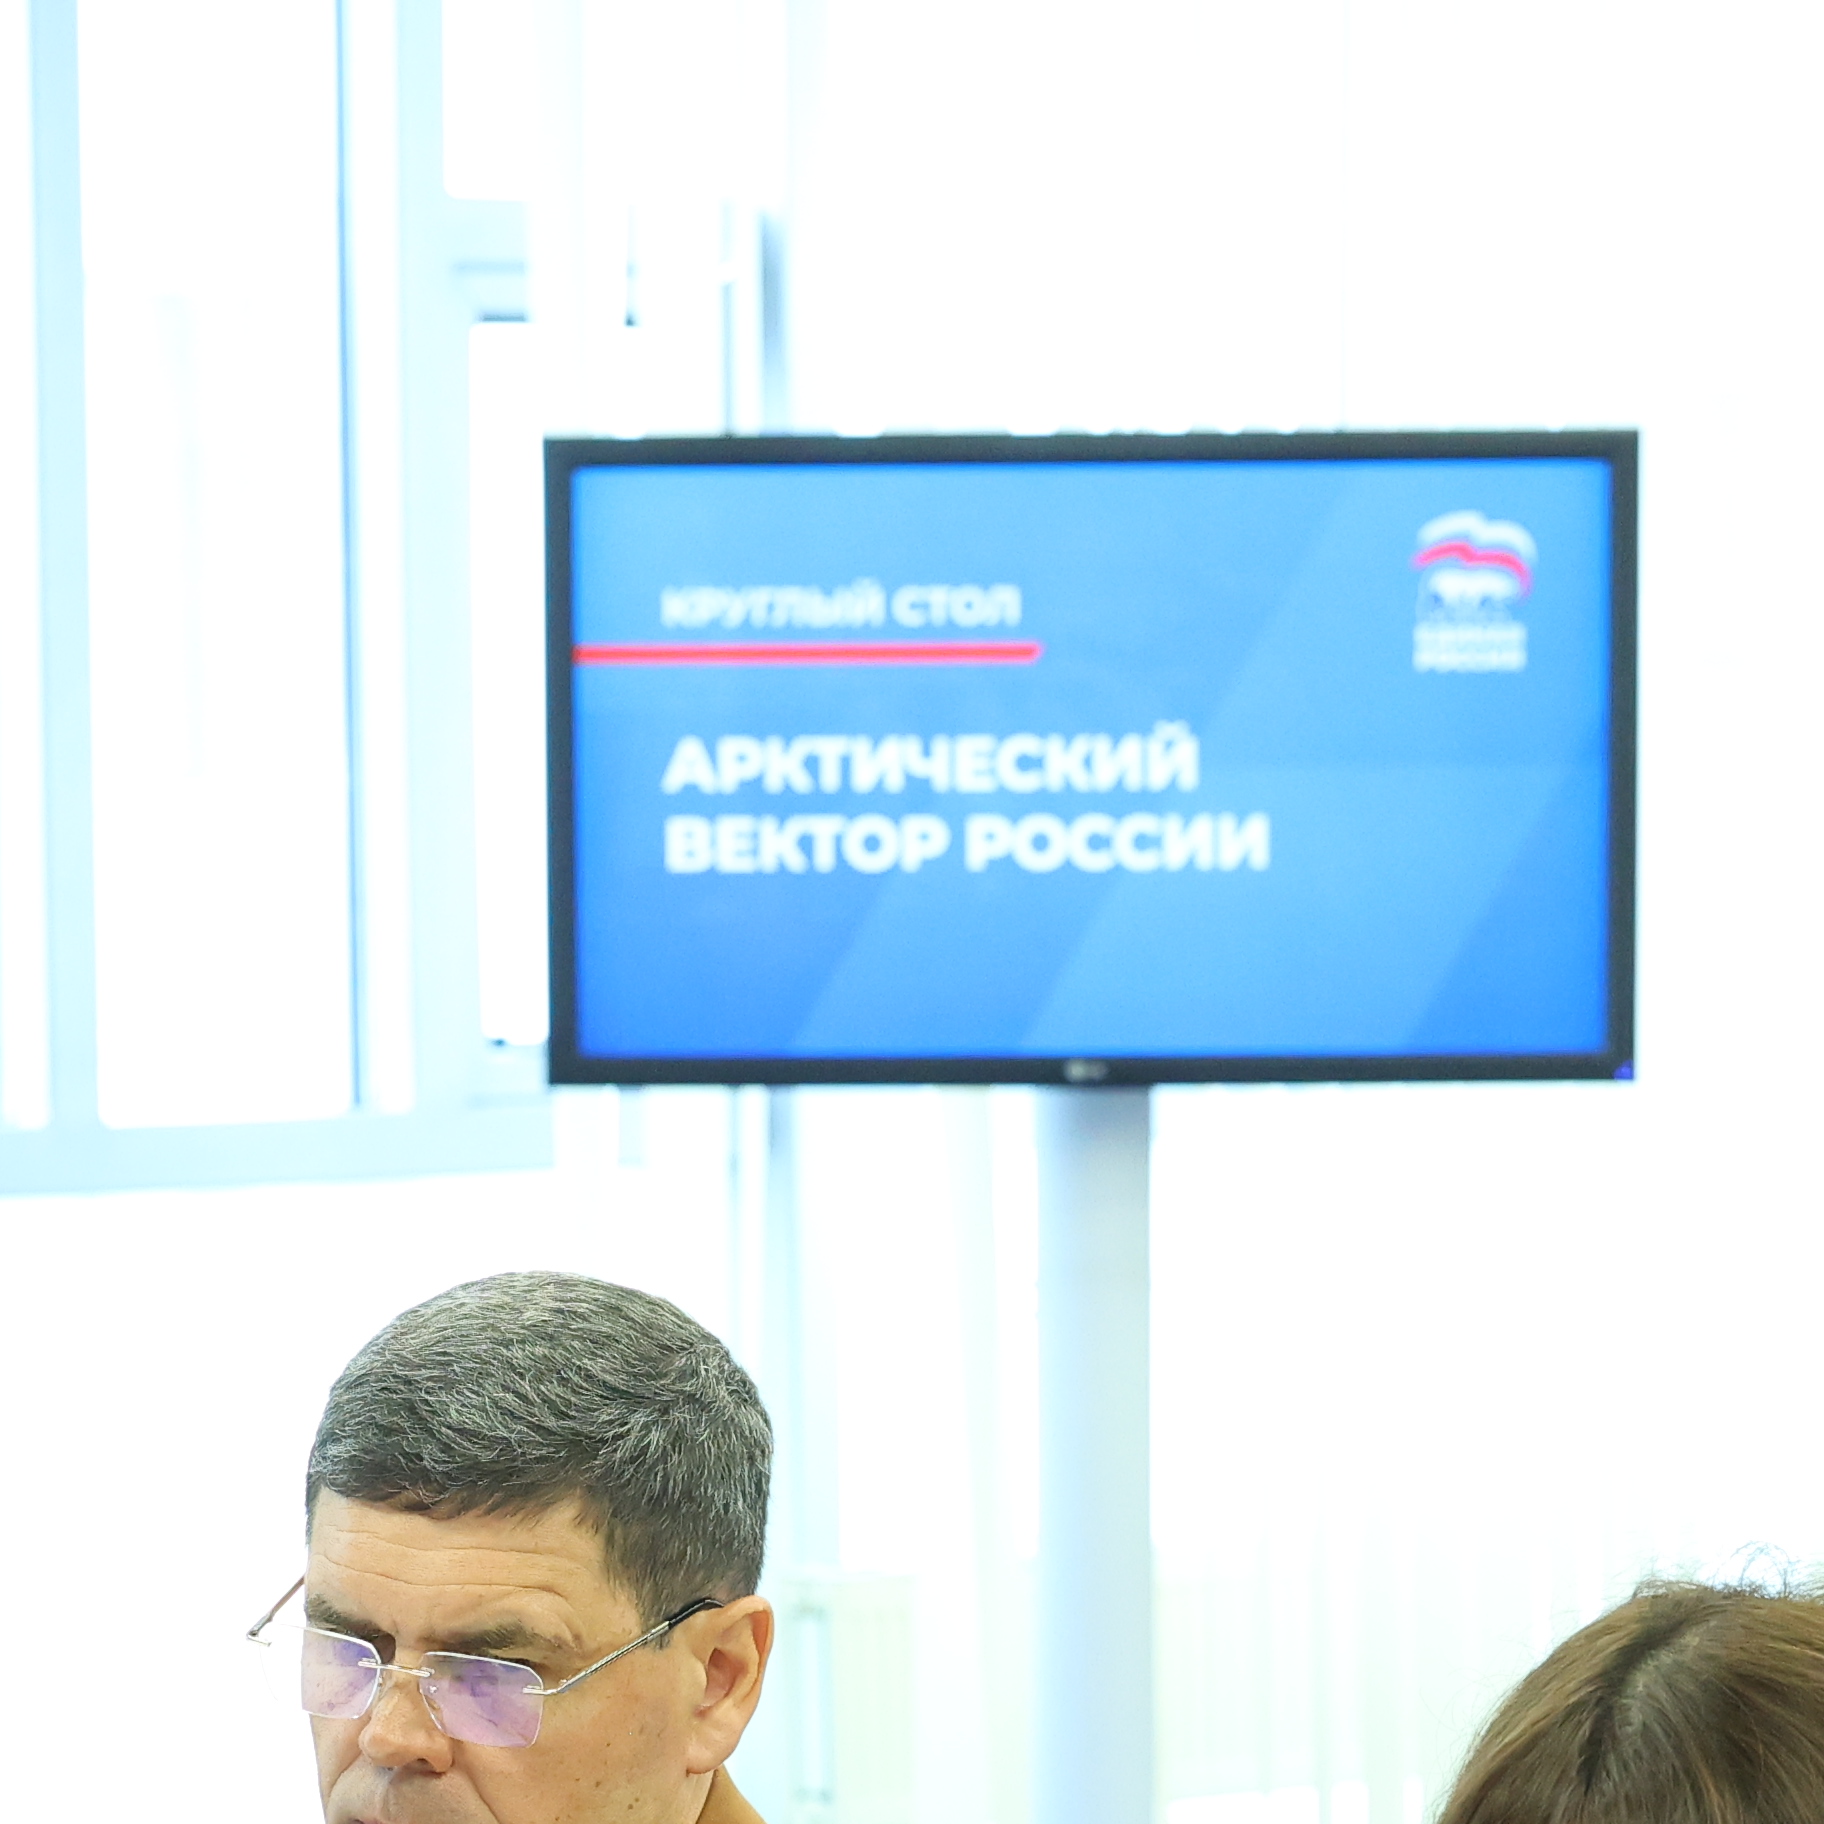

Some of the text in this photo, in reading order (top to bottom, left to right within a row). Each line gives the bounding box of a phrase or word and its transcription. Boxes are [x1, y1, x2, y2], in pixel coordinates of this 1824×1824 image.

[660, 577, 1022, 628] КРУГЛЫЙ СТОЛ
[662, 719, 1200, 794] АРКТИЧЕСКИЙ
[664, 813, 1271, 874] ВЕКТОР РОССИИ
